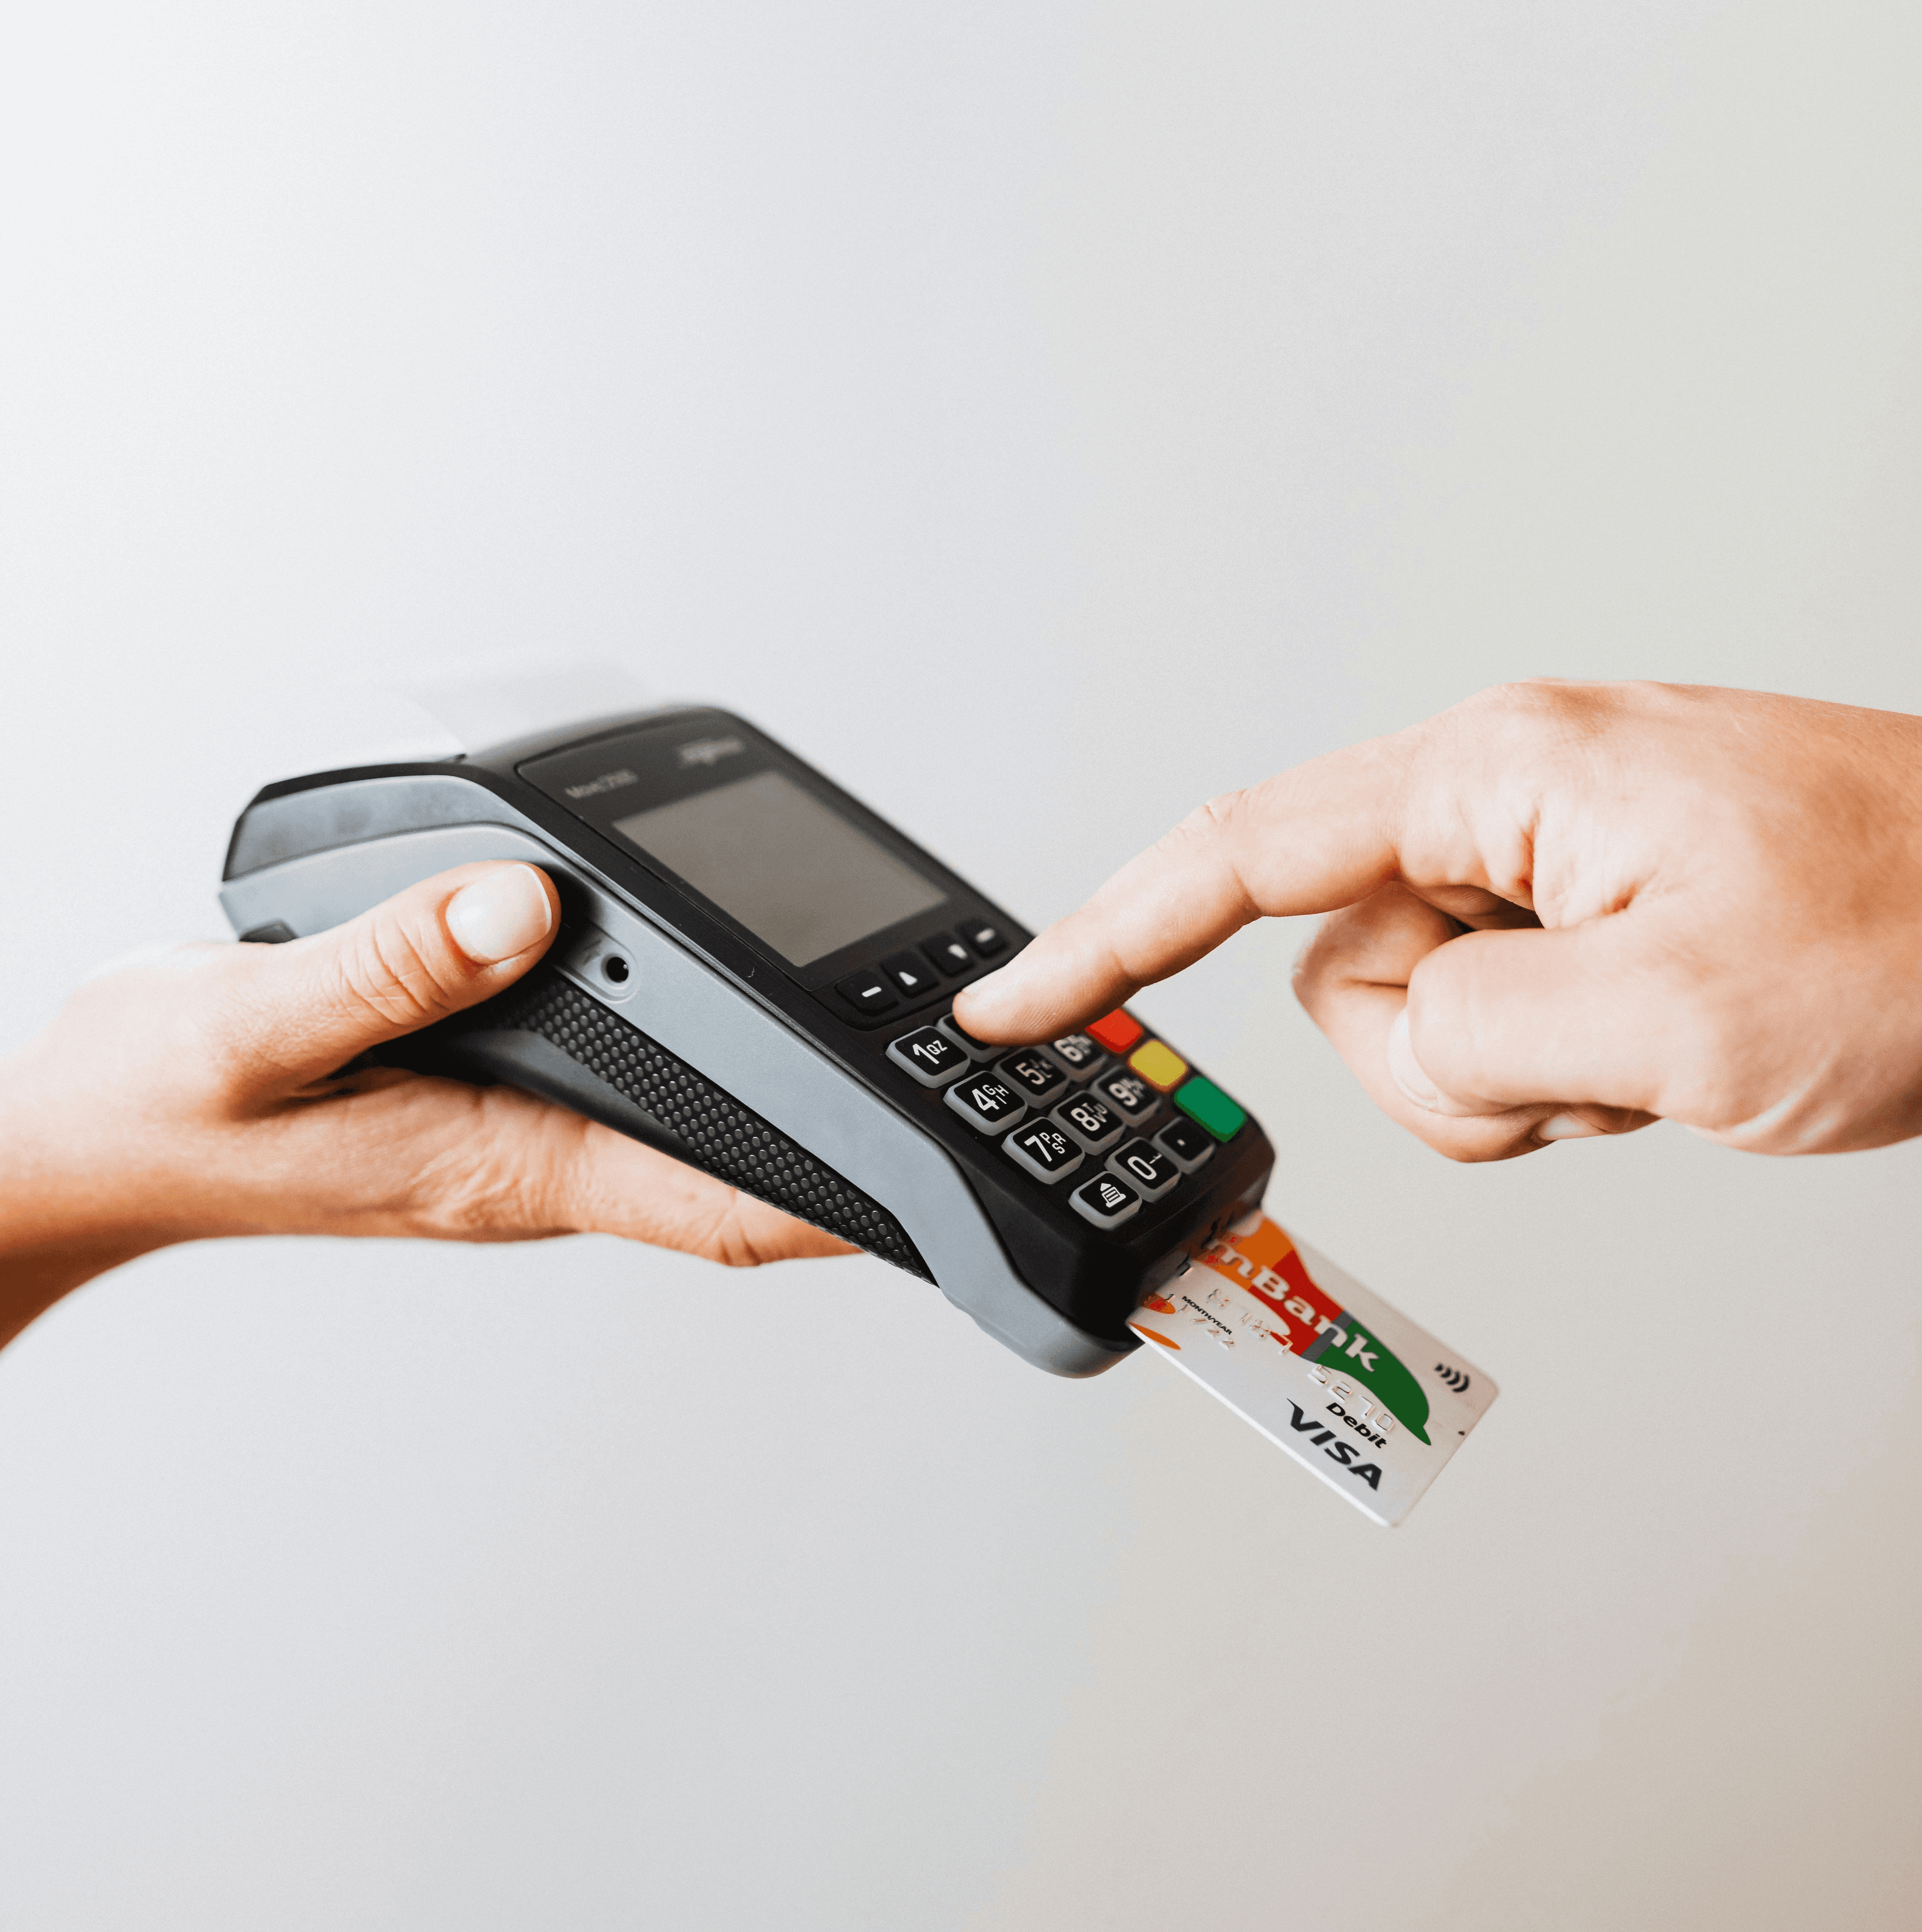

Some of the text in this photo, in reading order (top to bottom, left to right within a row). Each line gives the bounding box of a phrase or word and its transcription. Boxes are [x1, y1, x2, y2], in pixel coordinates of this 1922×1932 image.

[1182, 1296, 1232, 1335] MONTH/YEAR
[1207, 1239, 1380, 1373] mBank
[1307, 1365, 1394, 1433] 5270
[1326, 1402, 1387, 1448] Debit
[1287, 1398, 1382, 1491] VISA
